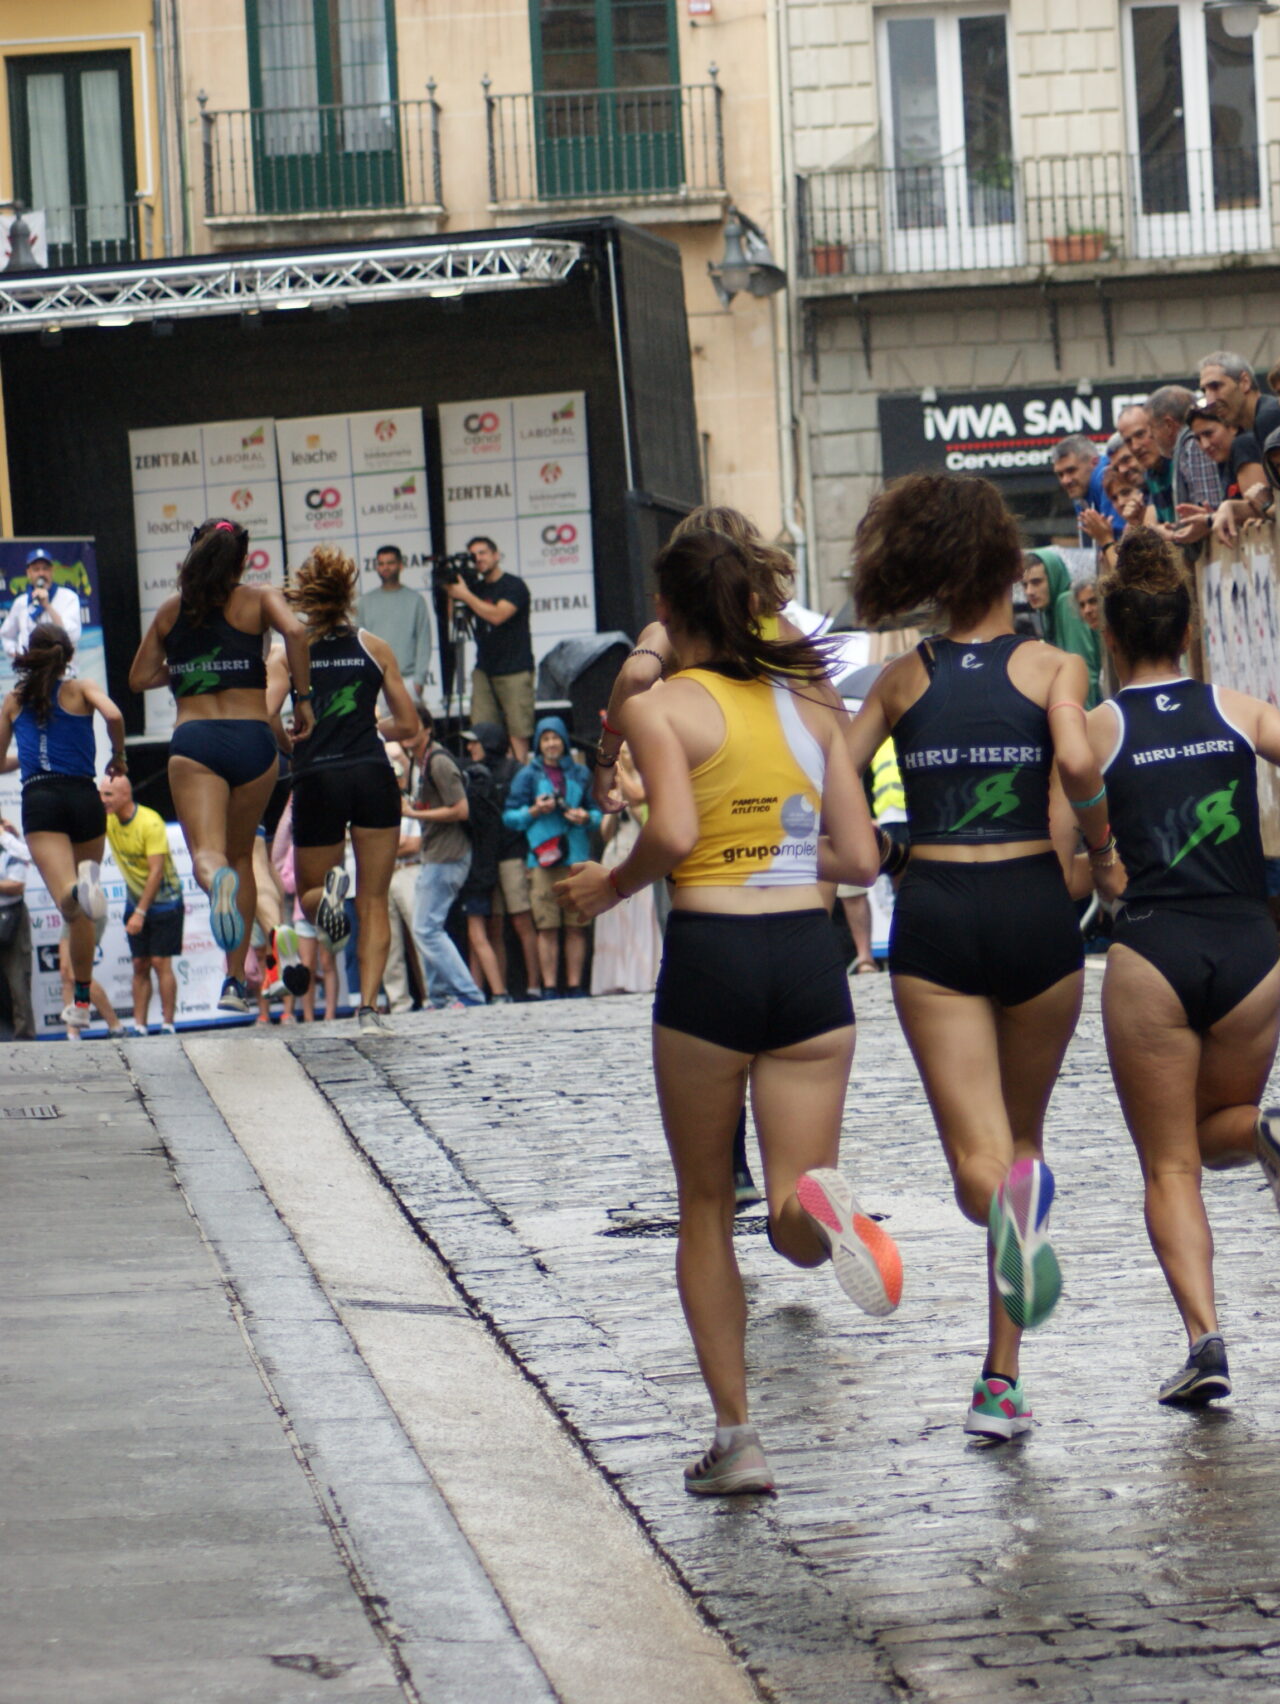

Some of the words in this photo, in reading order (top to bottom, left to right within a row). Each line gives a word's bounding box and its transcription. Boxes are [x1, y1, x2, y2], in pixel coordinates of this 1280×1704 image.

[1024, 398, 1101, 436] SAN
[520, 426, 575, 440] LABORAL
[135, 450, 199, 470] ZENTRAL
[210, 451, 265, 466] LABORAL
[291, 448, 338, 466] leache
[447, 483, 512, 502] ZENTRAL
[305, 508, 344, 522] canal
[362, 502, 416, 516] LABORAL
[147, 518, 195, 534] leache
[731, 797, 778, 807] PAMPLONA
